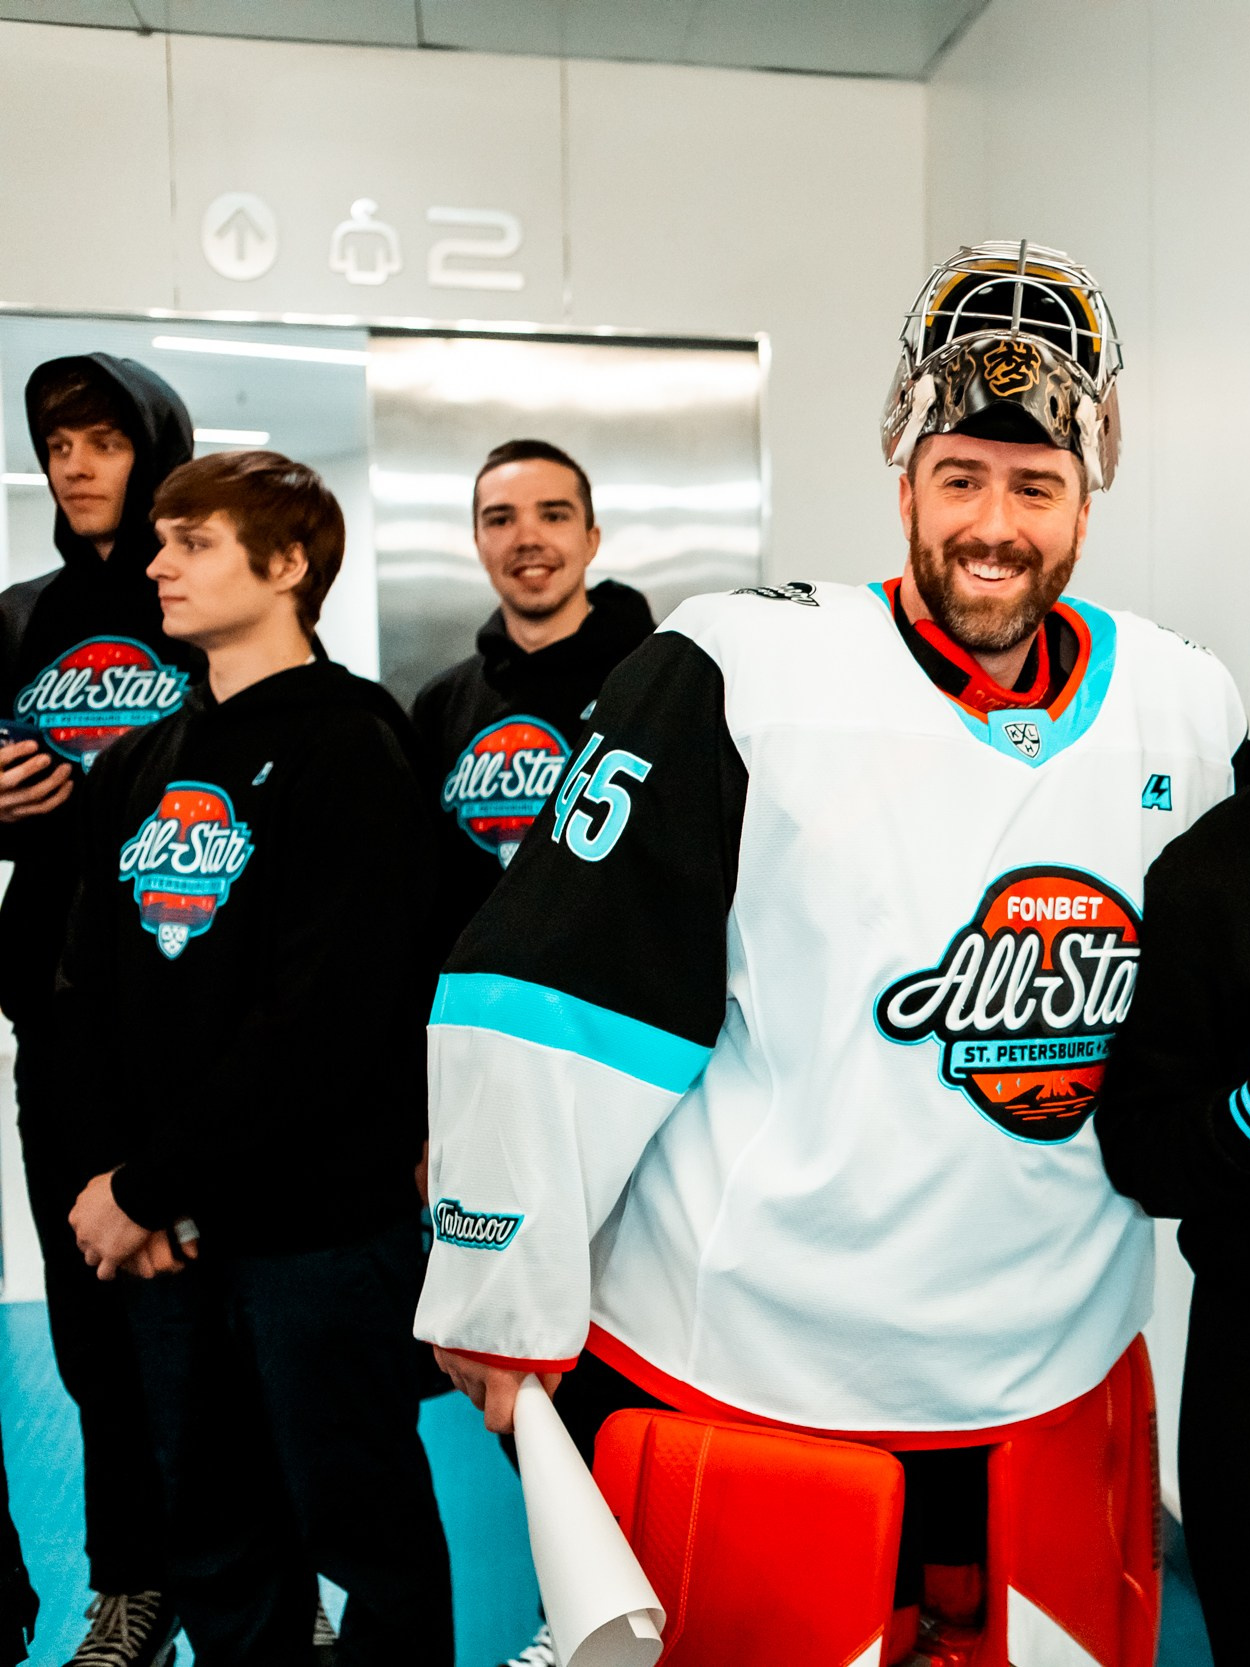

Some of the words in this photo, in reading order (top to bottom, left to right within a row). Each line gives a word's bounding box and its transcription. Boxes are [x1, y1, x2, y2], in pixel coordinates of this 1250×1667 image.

[426, 206, 525, 291] 2
[17, 664, 182, 713] All-Star
[444, 750, 565, 802] All-Sta
[551, 732, 652, 862] 45
[1007, 896, 1104, 922] FONBET
[887, 933, 1142, 1031] All-Sta
[963, 1046, 990, 1063] ST.
[997, 1041, 1095, 1062] PETERSBURG
[436, 1202, 516, 1242] Tarasov
